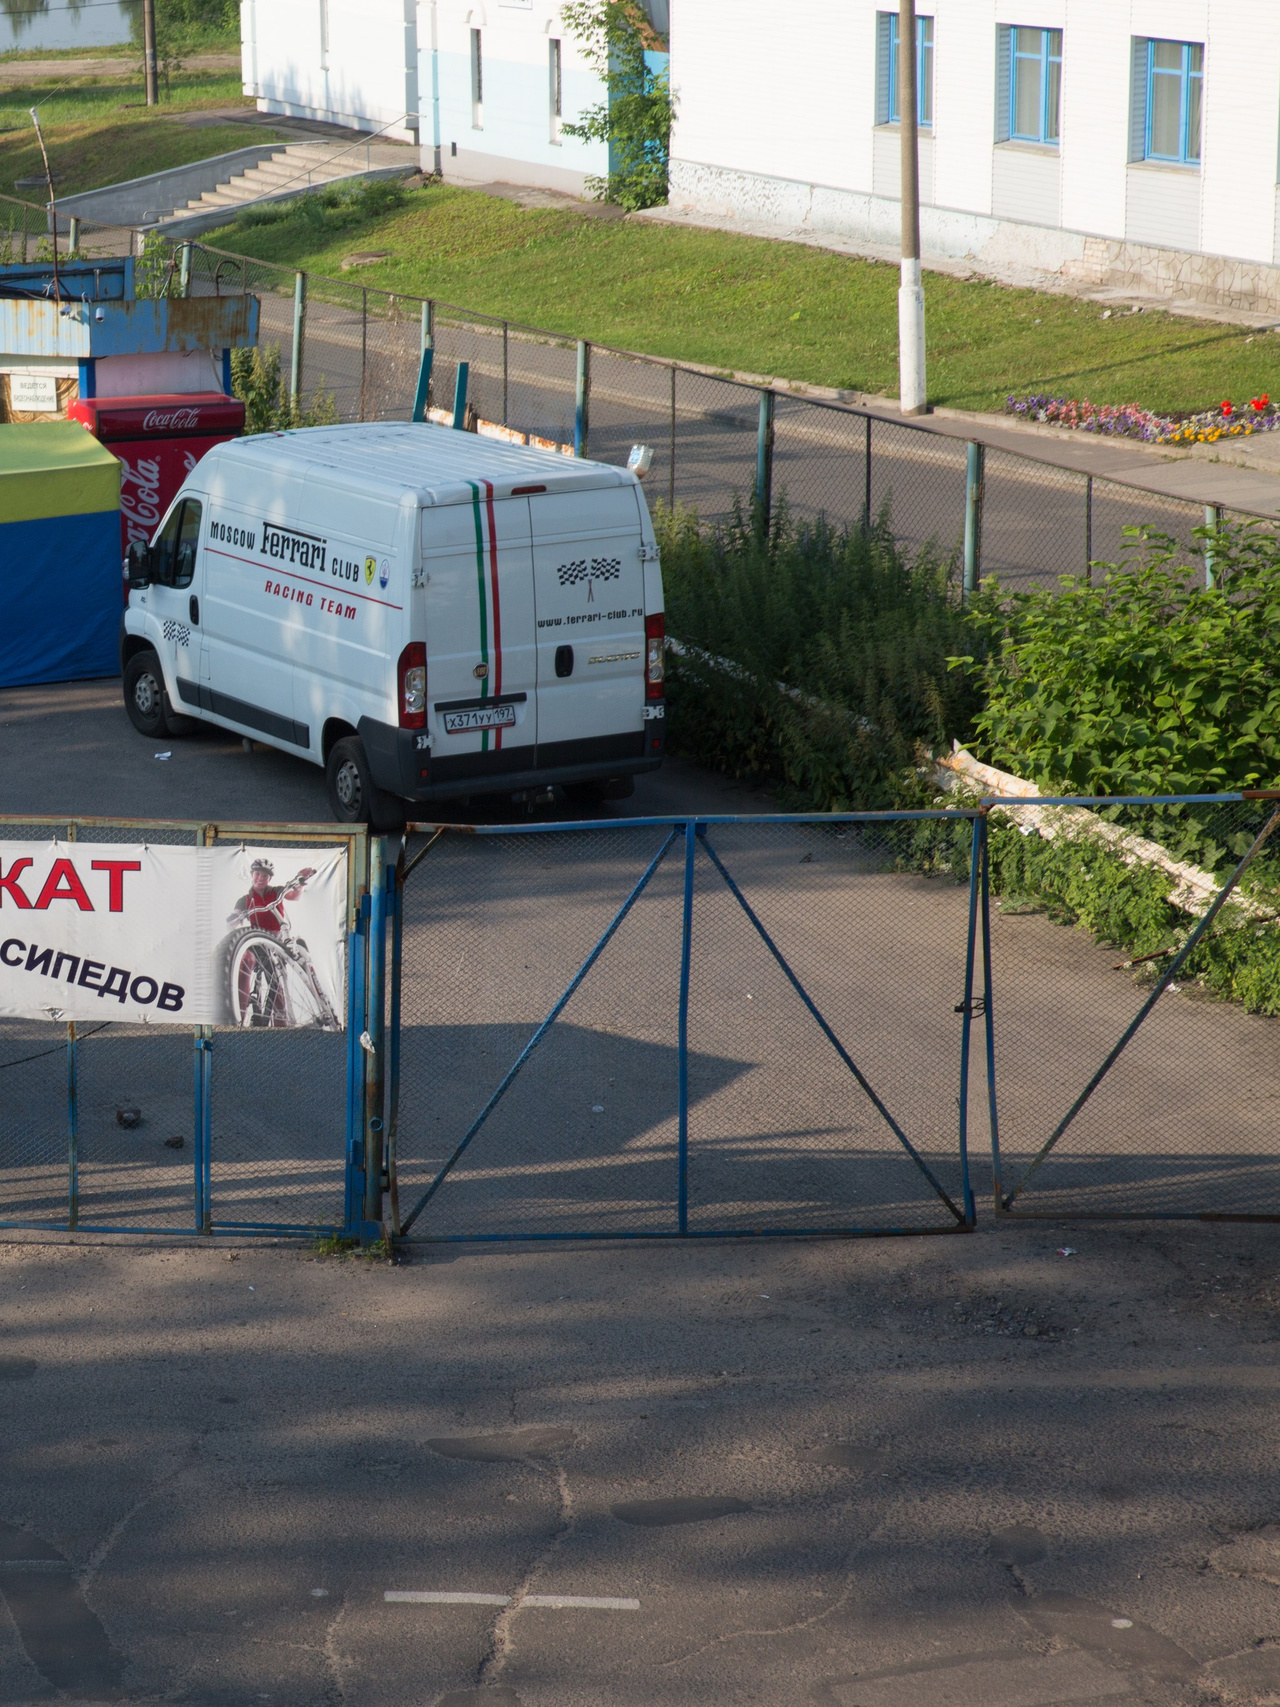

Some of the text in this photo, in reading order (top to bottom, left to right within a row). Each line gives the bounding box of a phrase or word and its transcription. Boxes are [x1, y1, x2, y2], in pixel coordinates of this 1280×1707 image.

[143, 408, 201, 431] Coca-Cola
[210, 521, 360, 582] MOSCOW Ferrari CLUB
[264, 580, 357, 620] RACING TEAM
[538, 608, 643, 628] www.ferrari-club.ru
